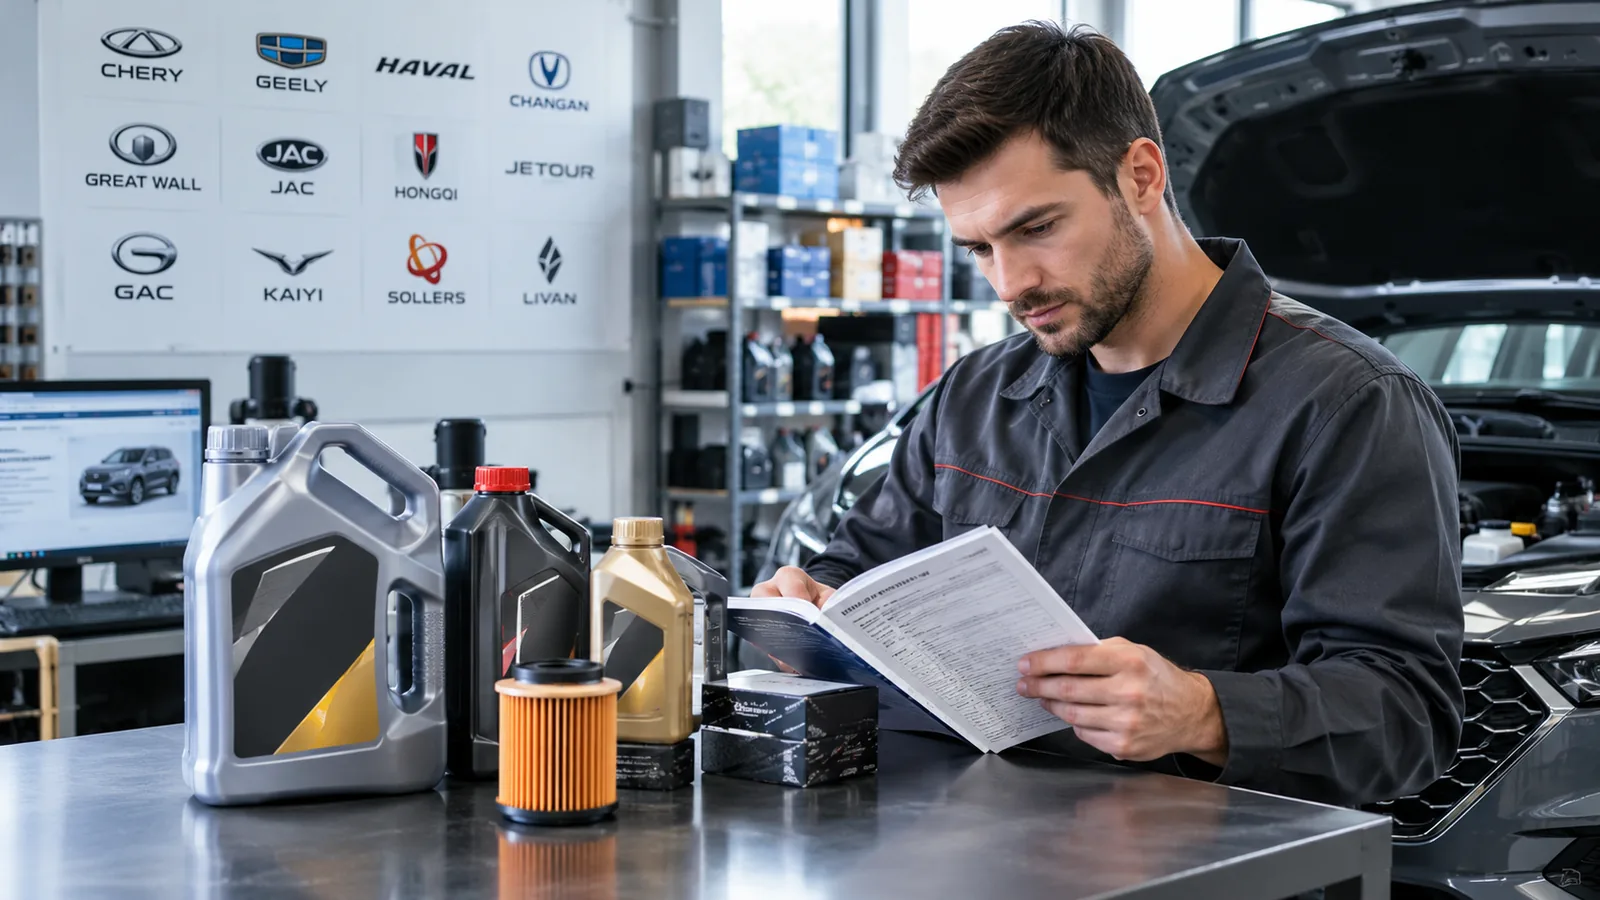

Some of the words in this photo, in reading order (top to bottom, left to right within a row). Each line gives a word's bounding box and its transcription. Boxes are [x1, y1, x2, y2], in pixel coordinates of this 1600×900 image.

[100, 63, 184, 83] CHERY
[375, 56, 475, 80] HAVAL
[255, 74, 328, 93] GEELY
[509, 94, 590, 112] CHANGAN
[266, 144, 320, 167] JAC
[505, 160, 595, 179] JETOUR
[85, 172, 148, 189] GREAT
[151, 176, 202, 191] WALL
[270, 180, 315, 196] JAC
[394, 186, 458, 201] HONGQI
[114, 284, 174, 301] GAC
[263, 287, 323, 302] KAIYI
[387, 290, 466, 305] SOLLERS
[523, 291, 577, 305] LIVAN
